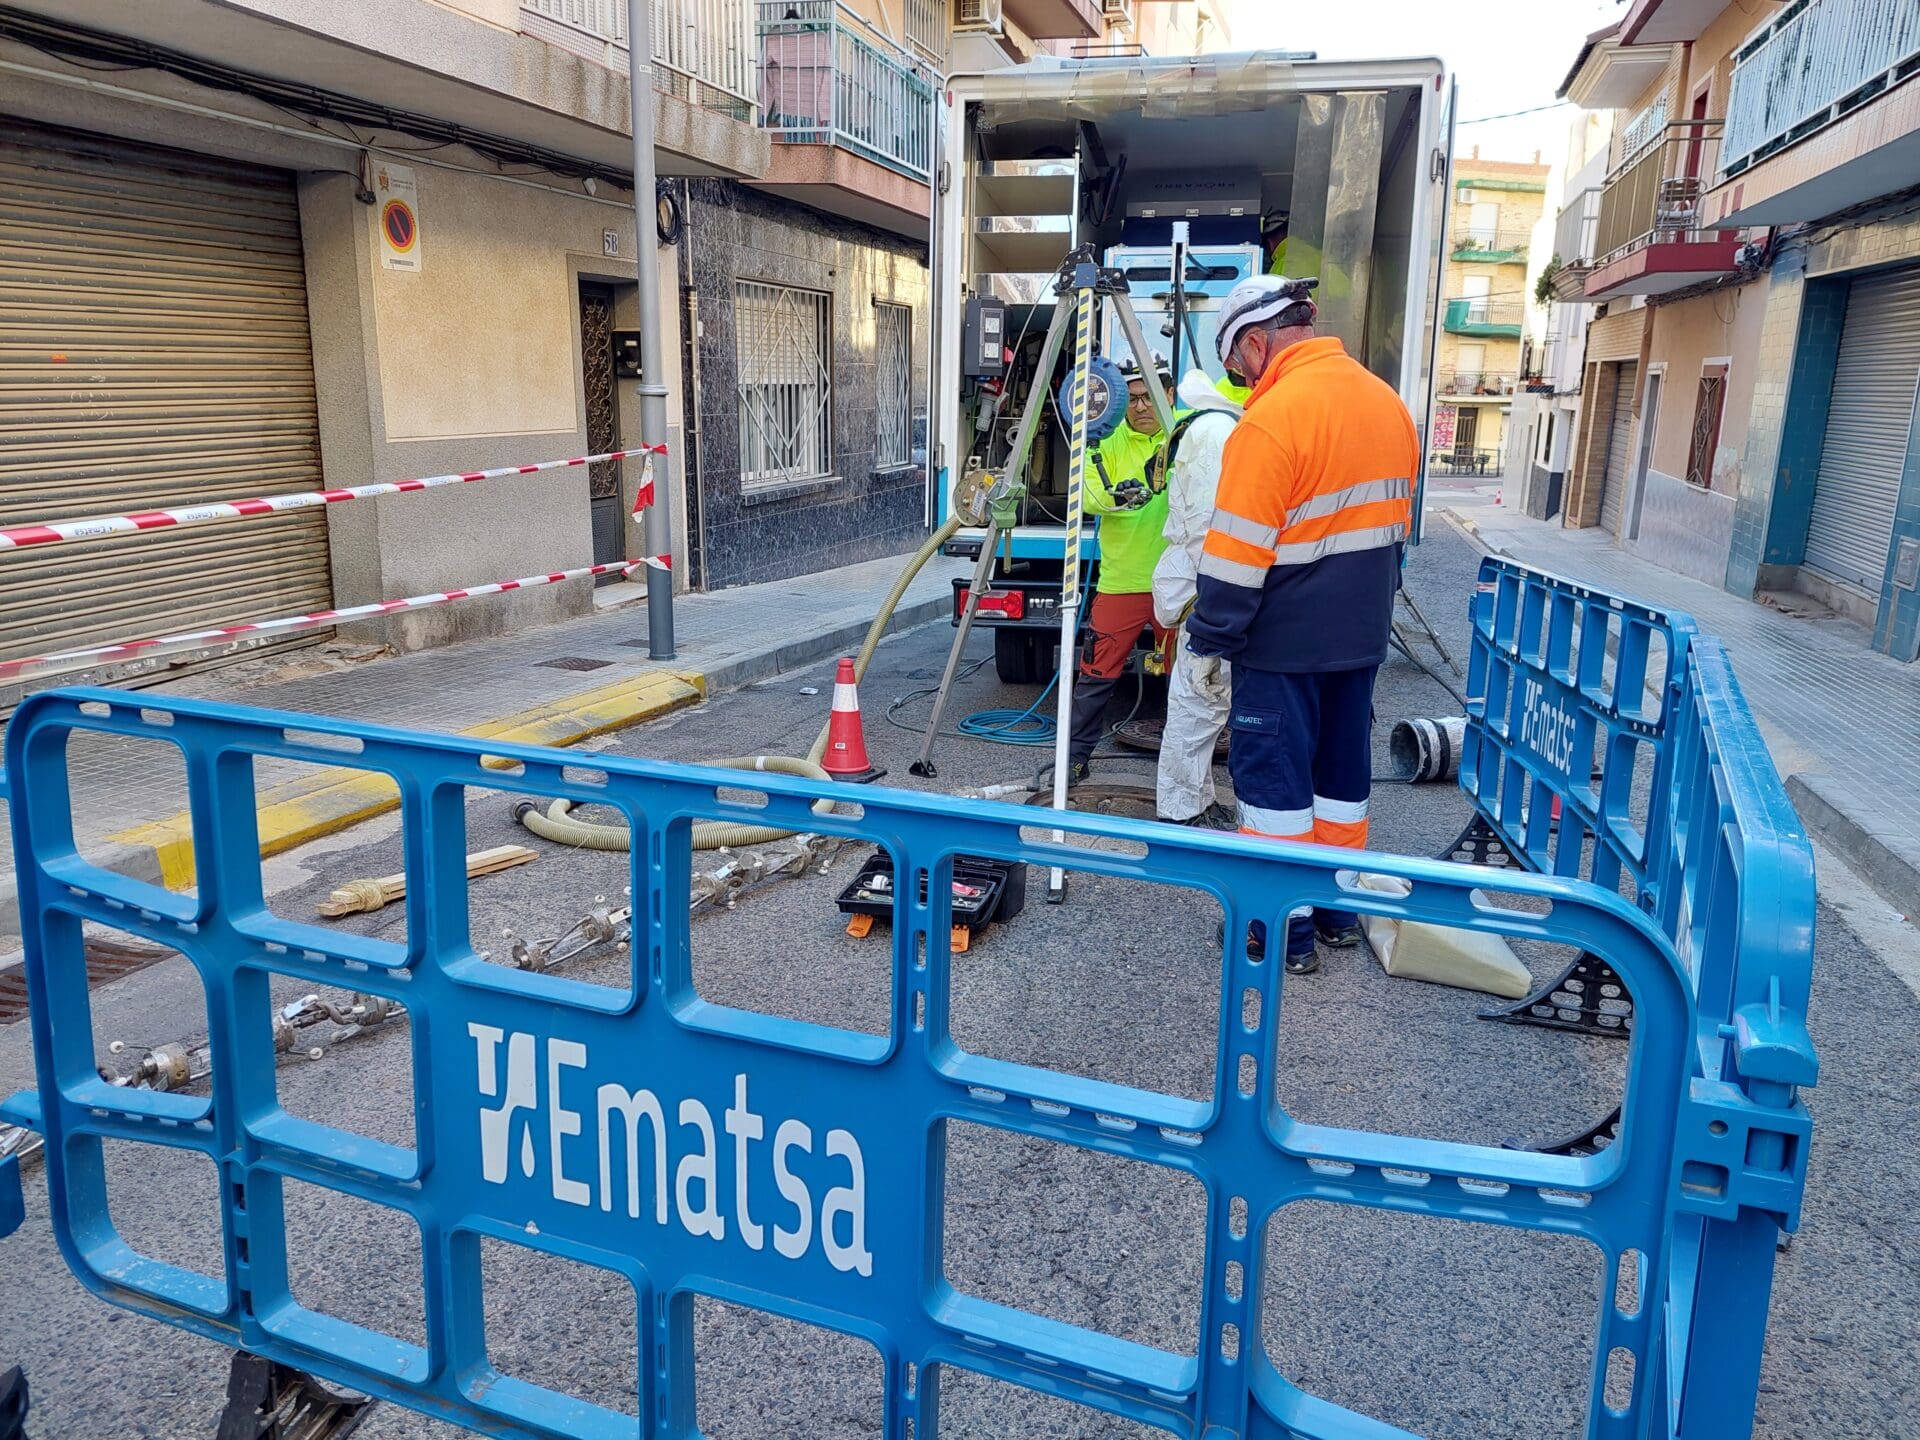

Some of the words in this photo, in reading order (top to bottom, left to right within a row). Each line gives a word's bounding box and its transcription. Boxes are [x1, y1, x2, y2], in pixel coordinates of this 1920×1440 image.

[605, 233, 618, 253] 5B
[1530, 683, 1577, 777] Ematsa
[548, 1037, 873, 1278] Ematsa
